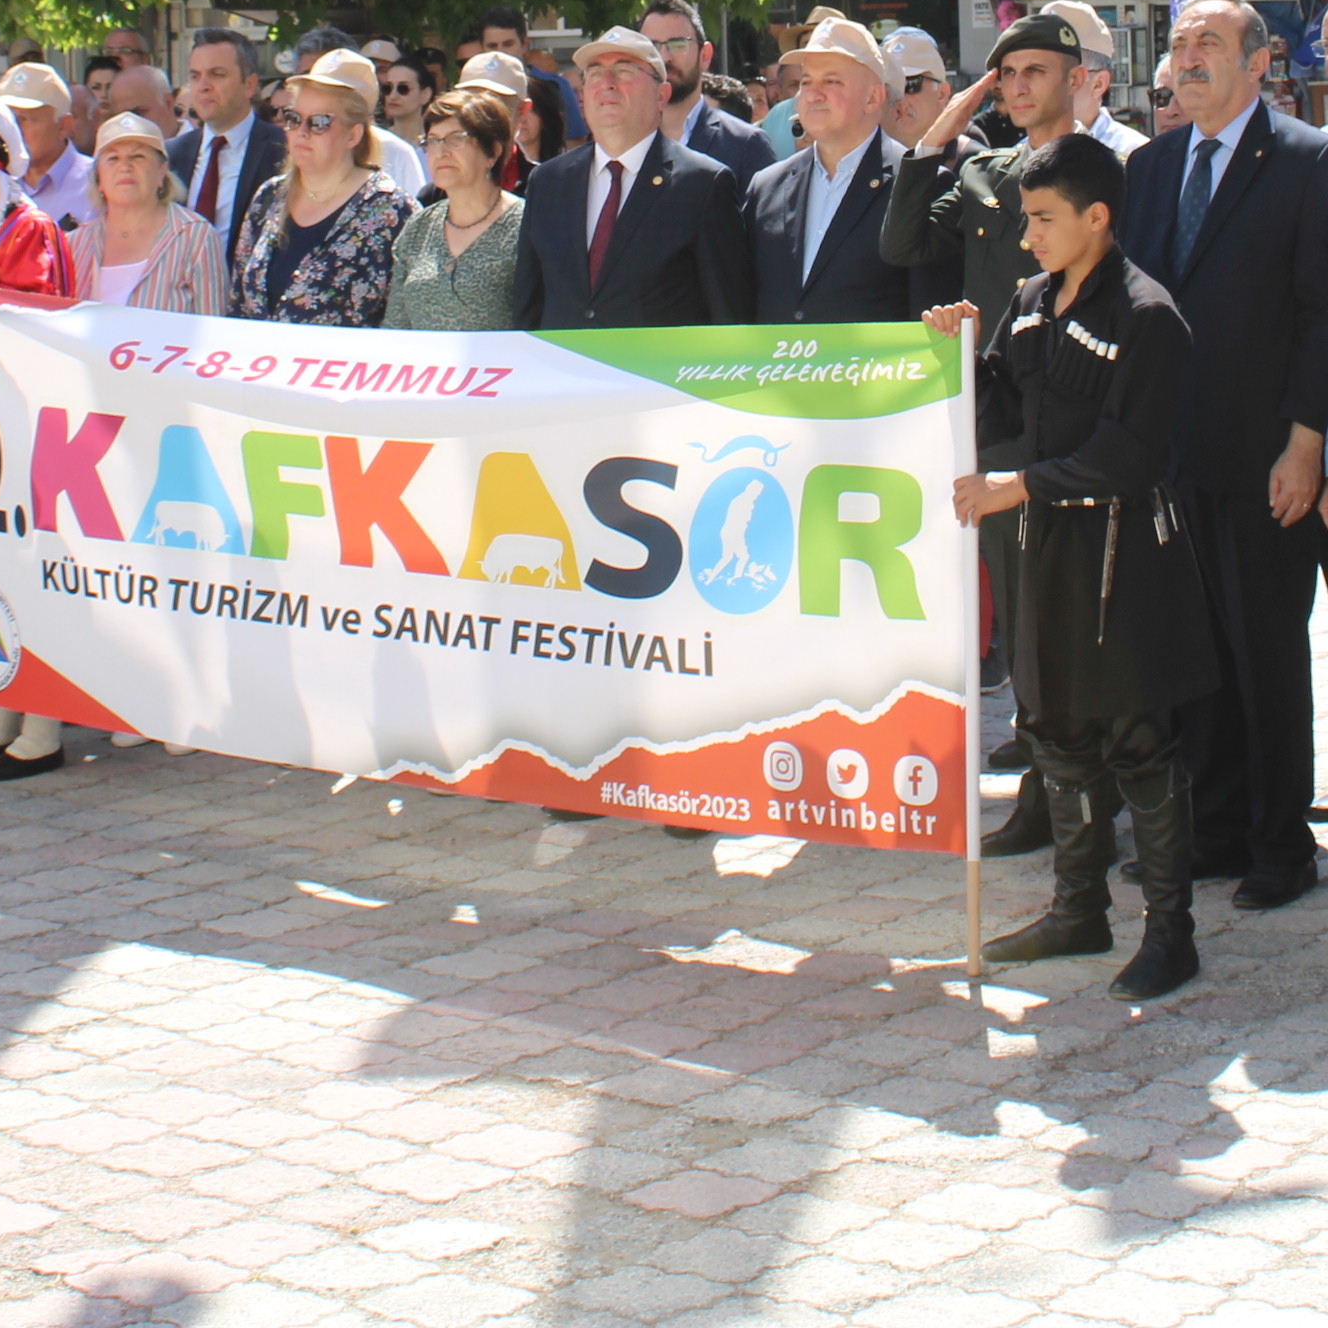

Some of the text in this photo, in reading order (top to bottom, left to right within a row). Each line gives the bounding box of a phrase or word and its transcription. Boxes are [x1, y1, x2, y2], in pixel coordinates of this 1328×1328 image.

[108, 340, 514, 399] 6-7-8-9 TEMMUZ
[675, 356, 928, 387] YILLIK GELENEĞİMİZ
[772, 339, 818, 360] 200
[29, 406, 928, 622] KAFKASÖR
[40, 555, 716, 678] KÜLTÜR TURİZM ve SANAT FESTİVALİ
[600, 780, 938, 836] #Kafkasör2023 artvinbeltr
